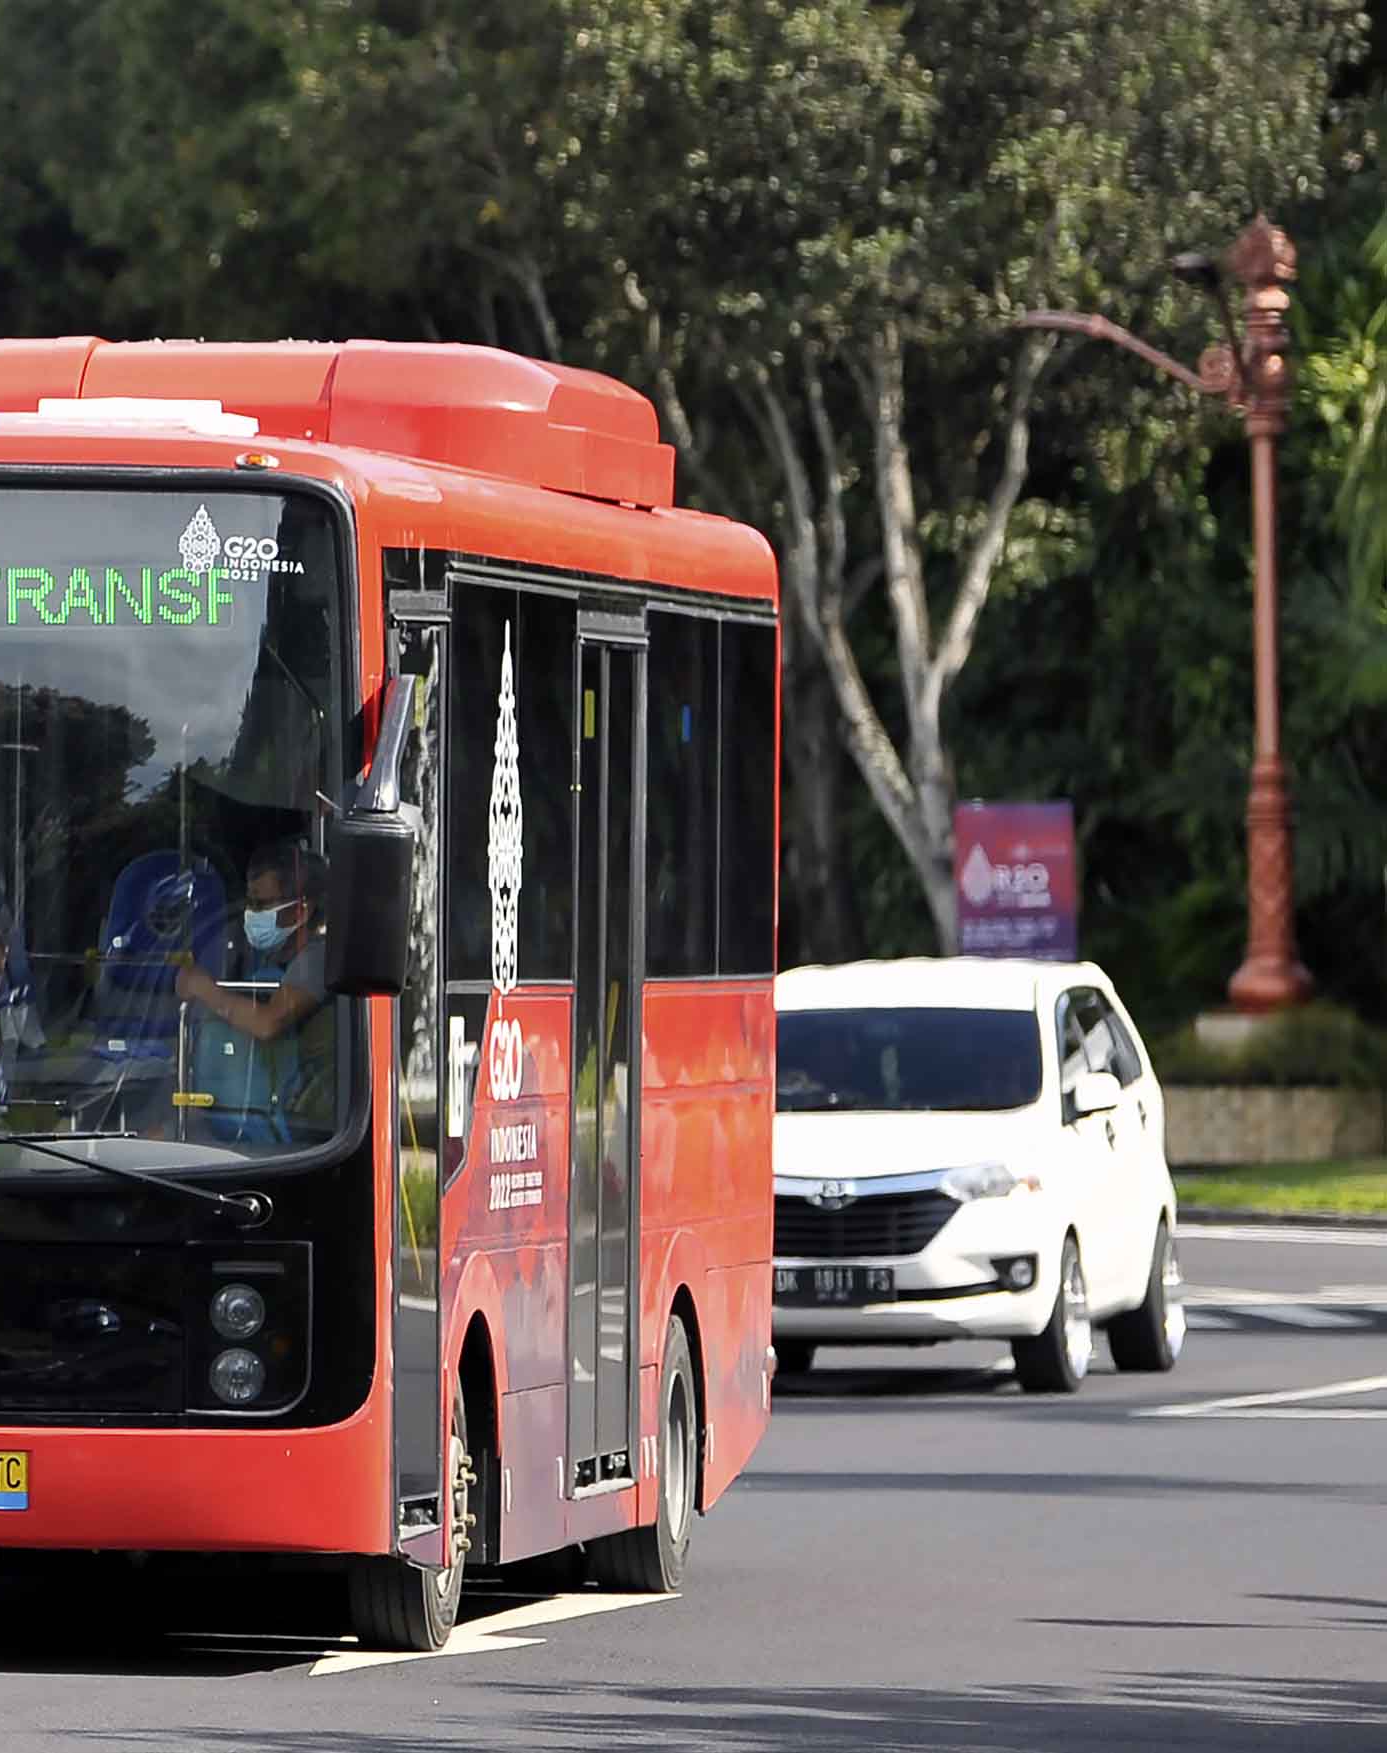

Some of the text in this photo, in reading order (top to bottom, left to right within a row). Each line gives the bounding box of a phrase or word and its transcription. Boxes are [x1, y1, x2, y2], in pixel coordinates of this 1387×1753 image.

[224, 536, 279, 560] G20
[223, 556, 305, 574] INDONESIA
[223, 568, 259, 582] 2022
[490, 1018, 523, 1101] G20
[491, 1124, 537, 1164] INDONESIA
